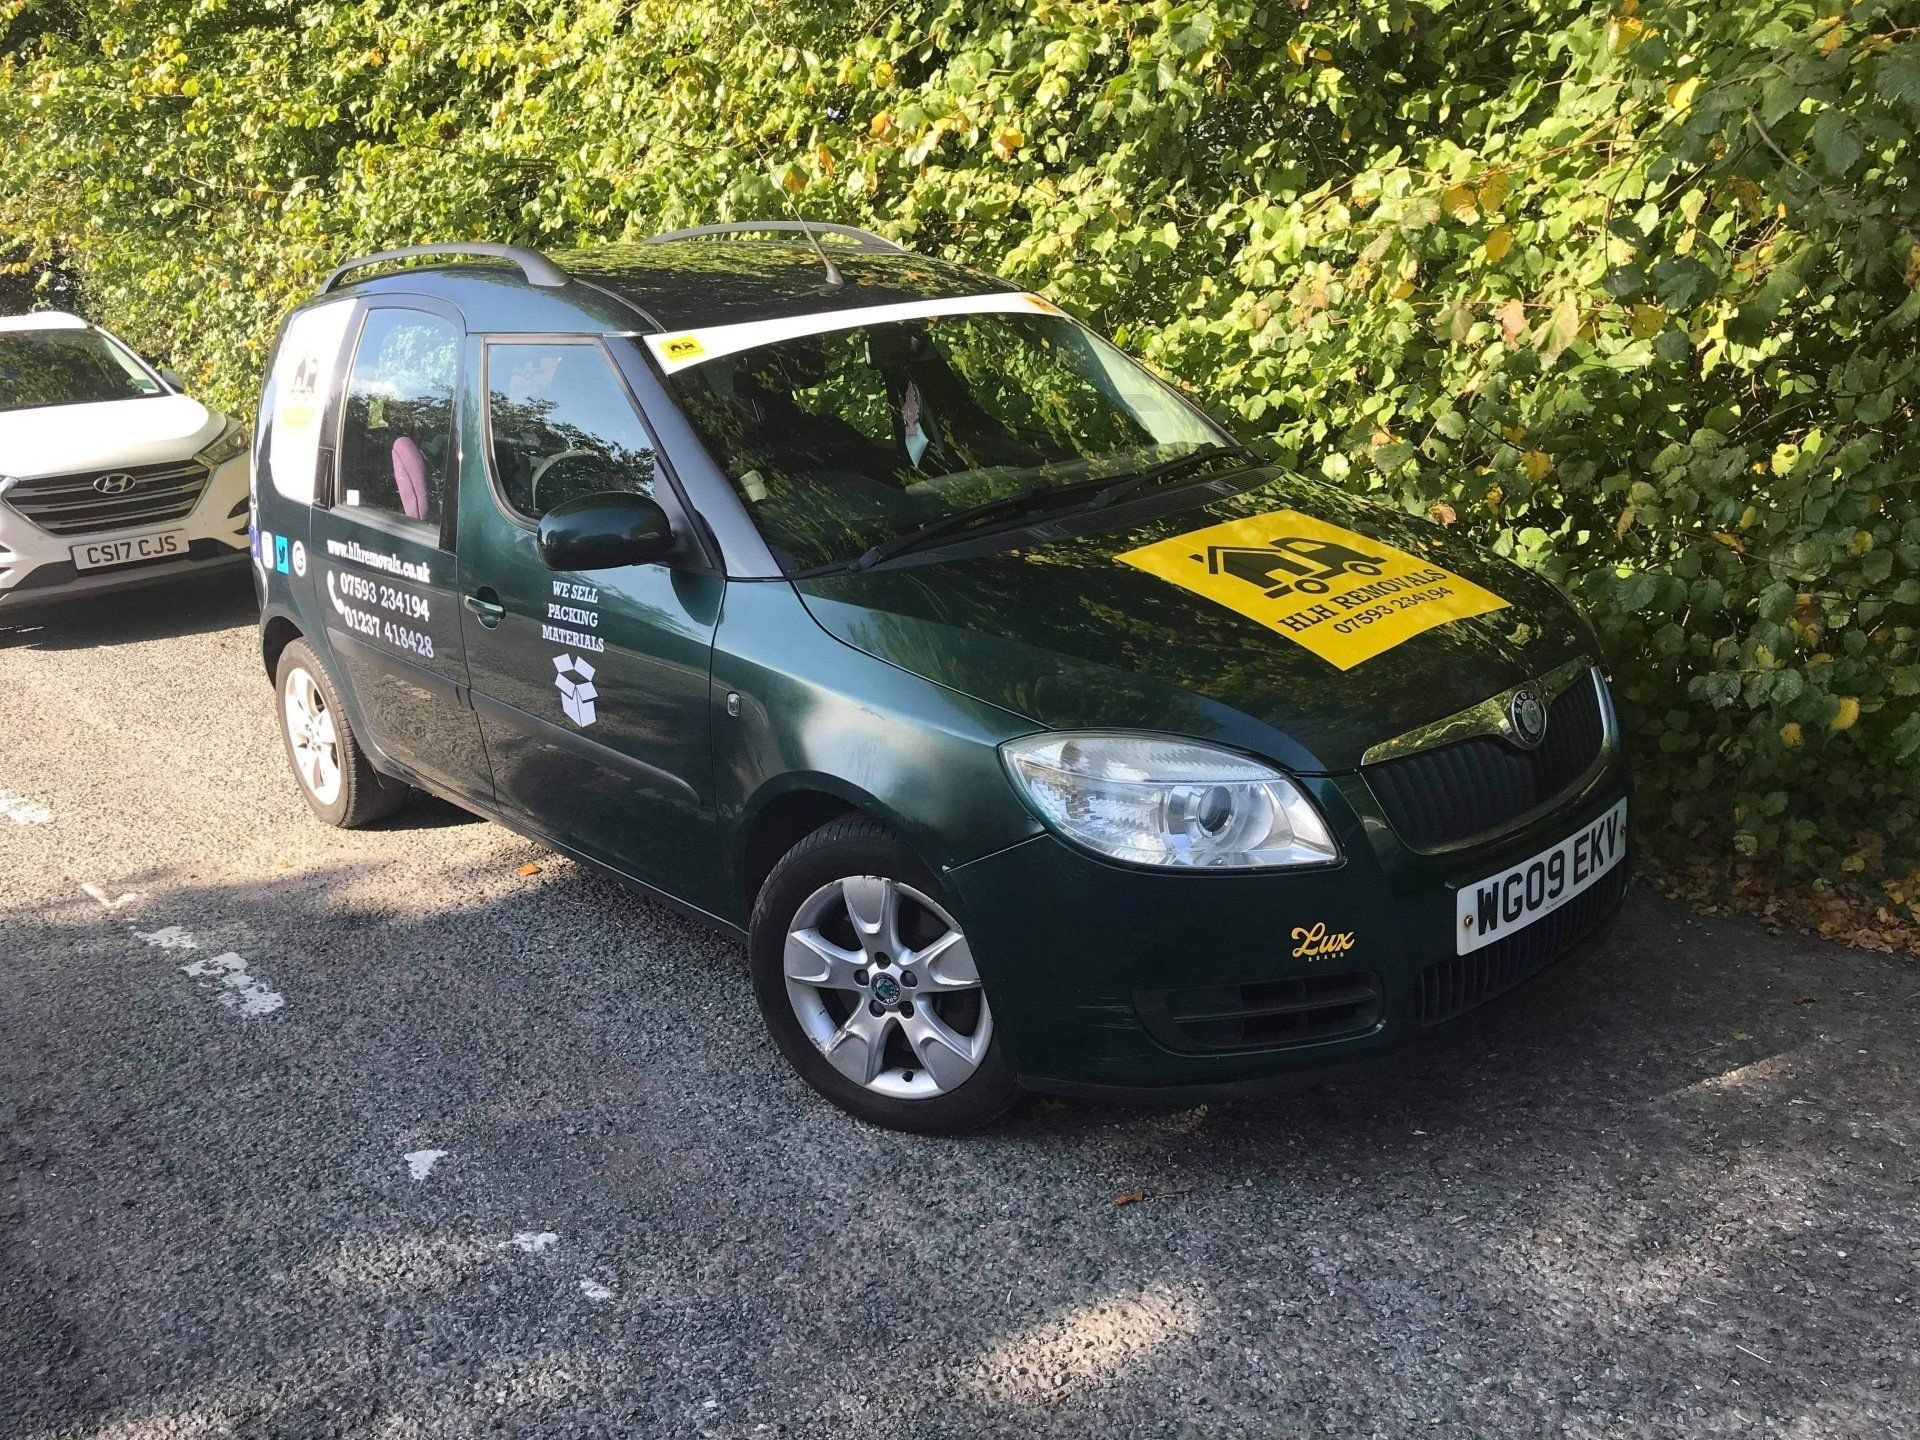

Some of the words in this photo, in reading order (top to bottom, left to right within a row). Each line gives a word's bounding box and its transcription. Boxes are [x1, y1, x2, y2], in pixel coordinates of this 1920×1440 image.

[86, 541, 132, 565] CS17
[138, 535, 178, 557] CJS
[326, 539, 431, 584] www.hlhremovals.co.uk
[340, 572, 377, 604] 07593
[380, 585, 430, 622] 234194
[552, 580, 571, 598] WE
[570, 584, 599, 604] SELL
[1277, 603, 1340, 632] HLH
[1329, 568, 1448, 610] REMOVALS
[1333, 605, 1394, 634] 07593
[1390, 586, 1455, 609] 234194
[344, 605, 381, 639] 01237
[384, 621, 435, 659] 418428
[547, 602, 599, 628] PACKING
[541, 624, 605, 653] MATERIALS
[1477, 849, 1566, 936] WG09
[1573, 810, 1619, 886] EKV
[1291, 922, 1355, 958] Lux
